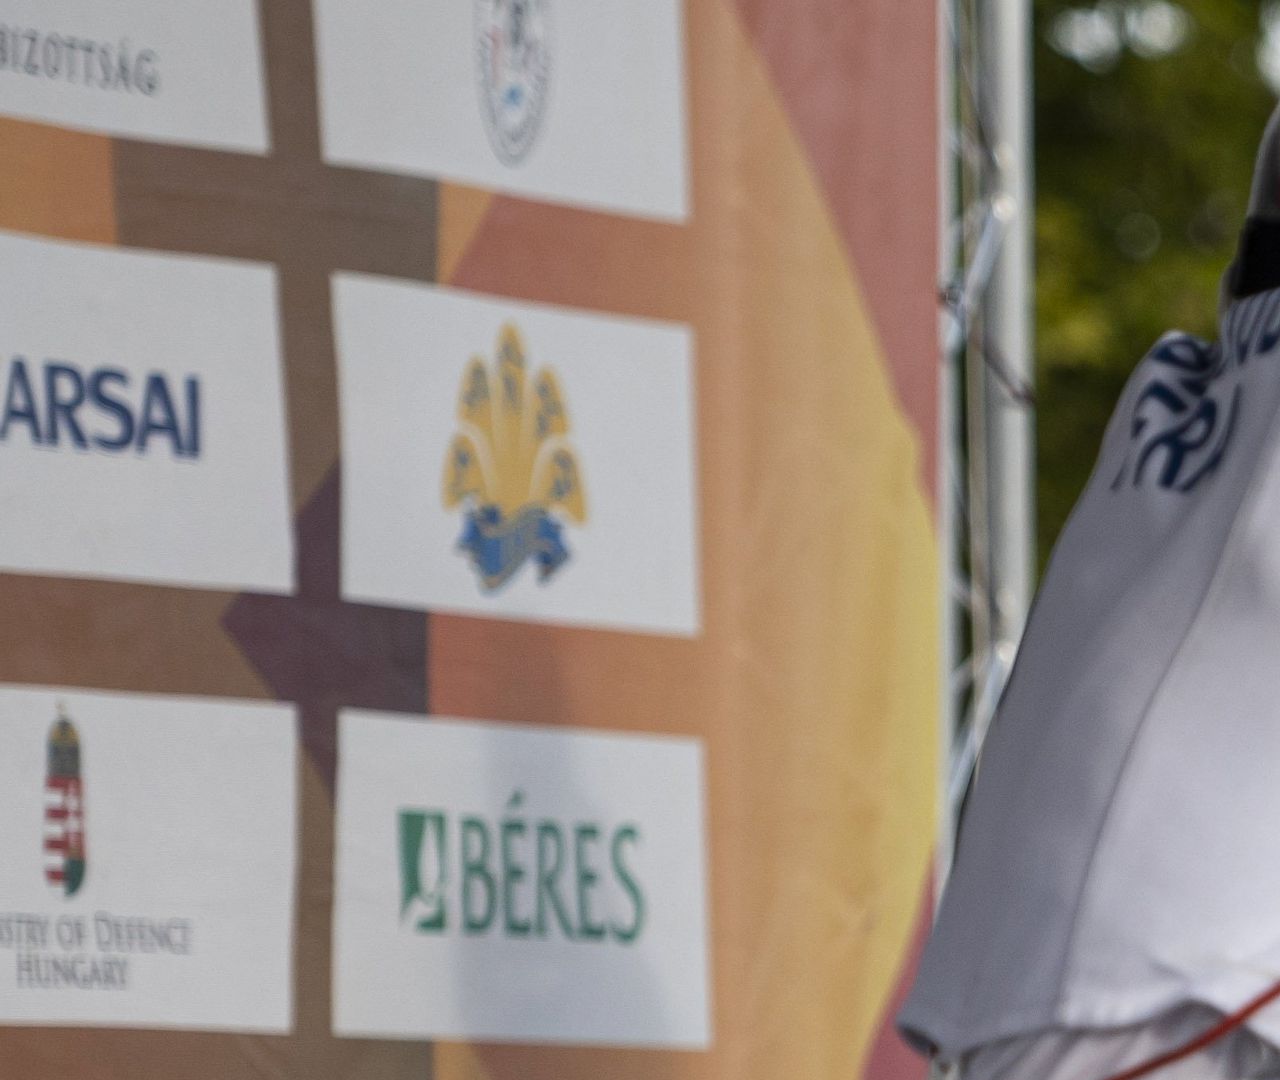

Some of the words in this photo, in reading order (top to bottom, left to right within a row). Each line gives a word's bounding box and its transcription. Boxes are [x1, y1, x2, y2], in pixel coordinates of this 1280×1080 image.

[460, 789, 645, 945] BÉRES
[55, 913, 87, 951] OF
[16, 952, 129, 991] HUNGARY
